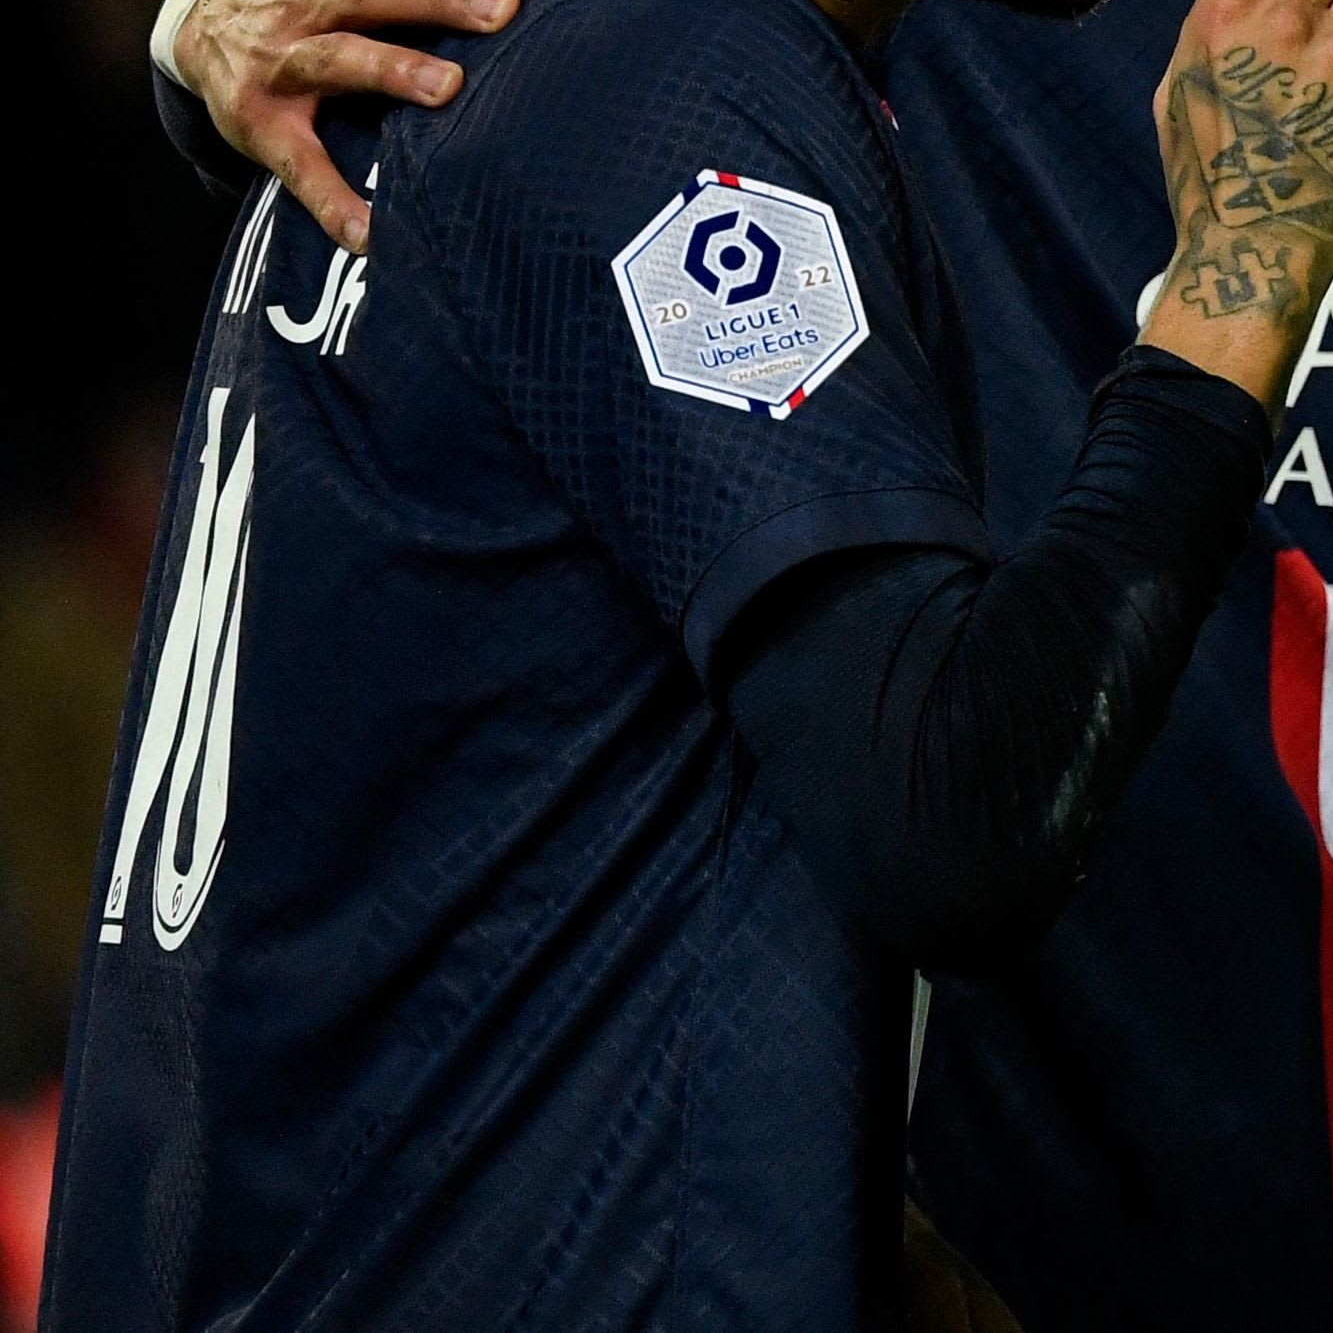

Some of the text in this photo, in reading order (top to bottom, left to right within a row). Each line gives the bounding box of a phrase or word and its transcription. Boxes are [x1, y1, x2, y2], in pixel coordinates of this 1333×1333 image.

[801, 266, 832, 287] 22
[656, 302, 688, 324] 20
[705, 304, 800, 341] LIGUE 1
[700, 328, 819, 368] Uber Eats
[729, 359, 802, 384] CHAMPION
